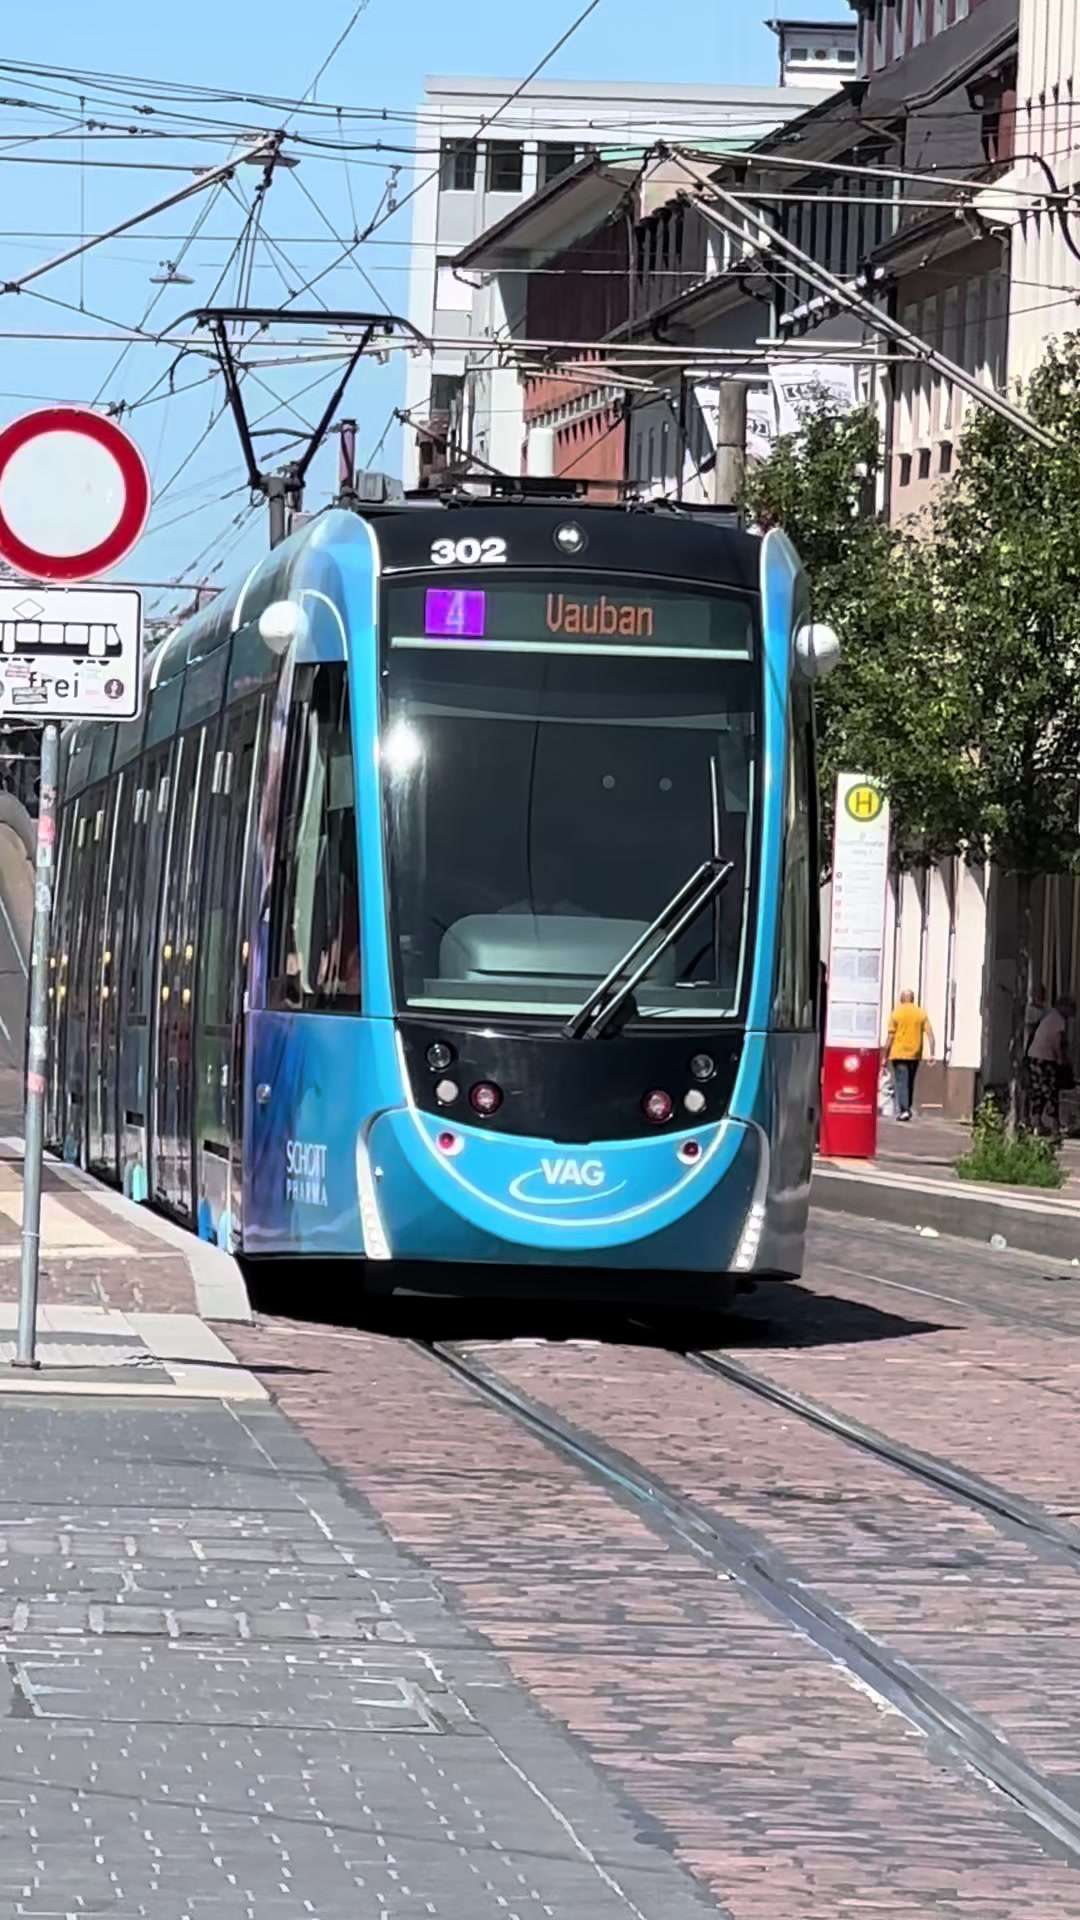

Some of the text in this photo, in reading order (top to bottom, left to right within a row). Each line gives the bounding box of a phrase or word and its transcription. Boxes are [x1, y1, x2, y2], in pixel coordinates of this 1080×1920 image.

[430, 537, 507, 564] 302
[445, 590, 653, 636] 4 Vauban
[855, 791, 872, 814] H
[286, 1139, 328, 1178] SCHOTT
[540, 1158, 605, 1186] VAG
[286, 1179, 328, 1207] PHARMA
